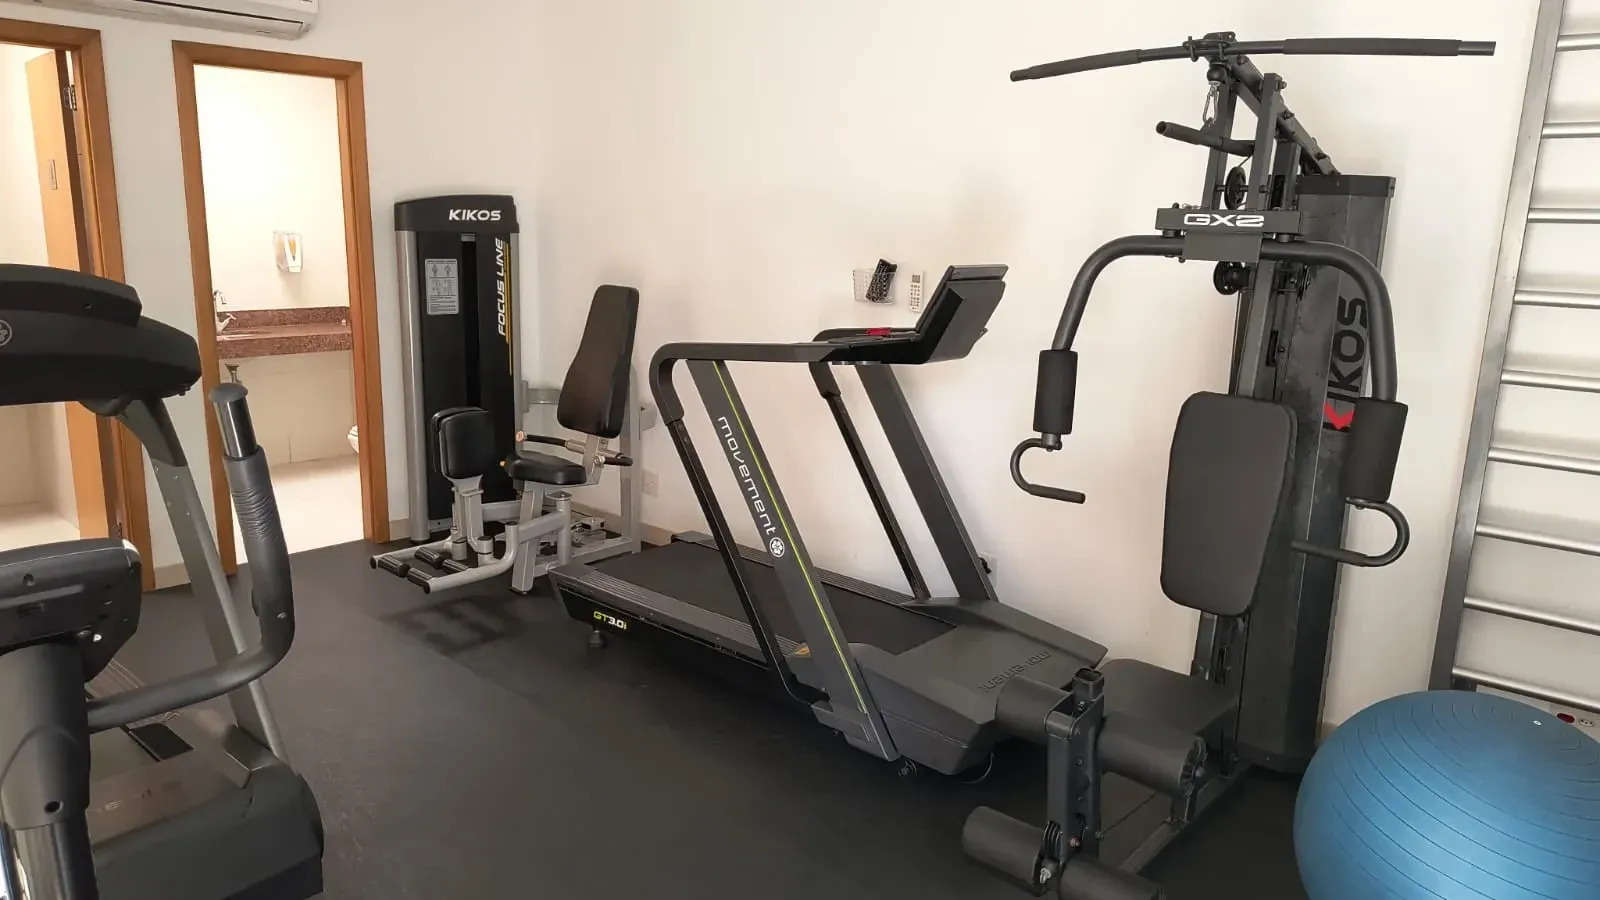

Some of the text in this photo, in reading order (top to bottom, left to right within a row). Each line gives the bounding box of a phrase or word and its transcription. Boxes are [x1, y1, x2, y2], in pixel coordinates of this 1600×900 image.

[448, 209, 502, 221] KIKOS
[1184, 213, 1265, 228] GX2
[494, 237, 506, 336] FOCUS LINE
[1322, 295, 1368, 433] KIKOS
[717, 415, 777, 536] movement
[593, 610, 627, 630] GT3.0i
